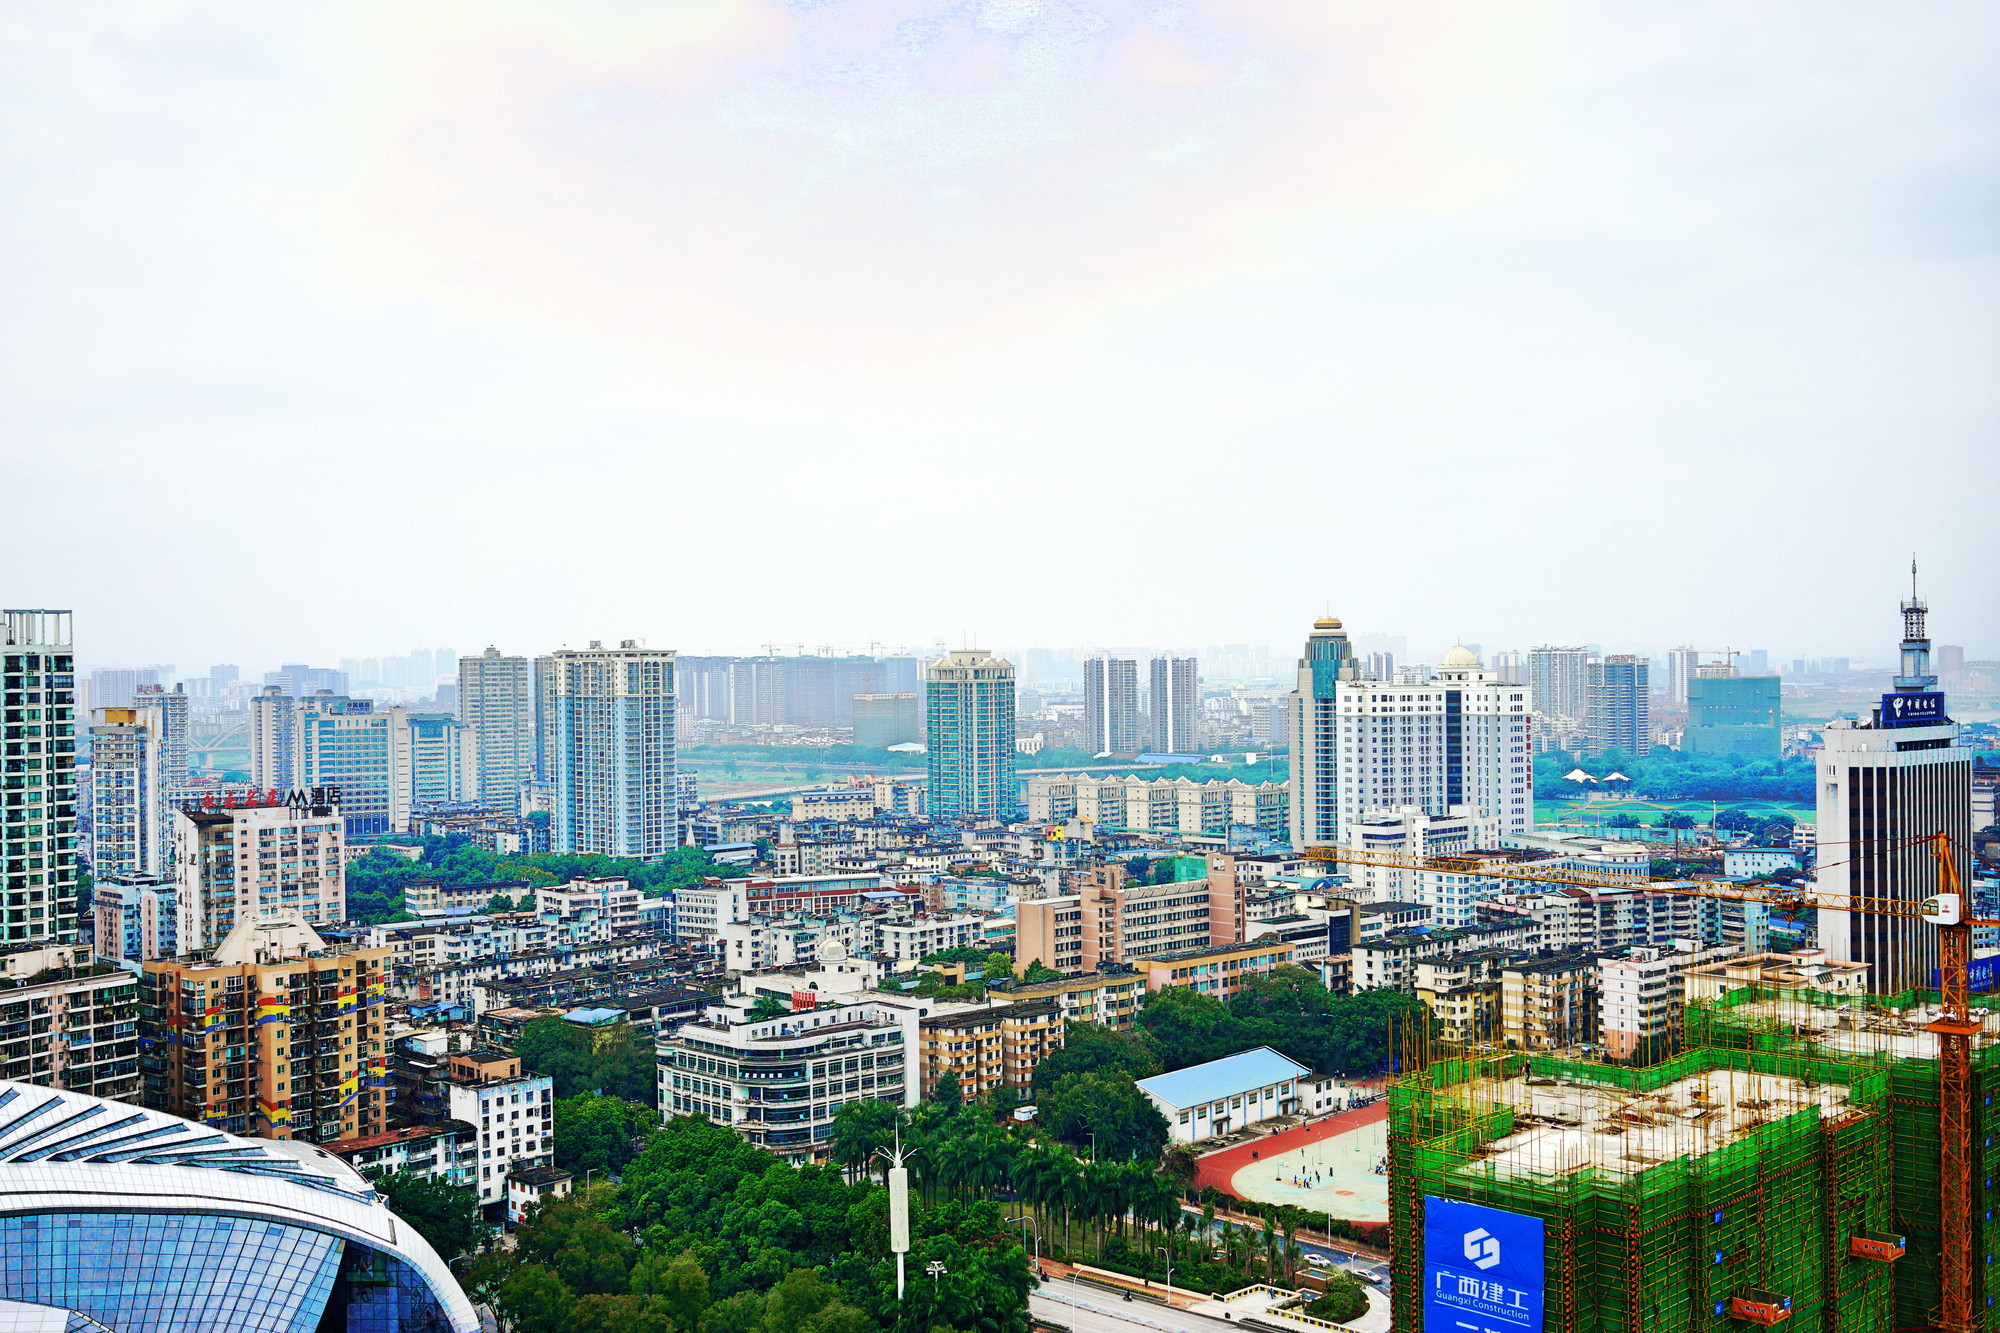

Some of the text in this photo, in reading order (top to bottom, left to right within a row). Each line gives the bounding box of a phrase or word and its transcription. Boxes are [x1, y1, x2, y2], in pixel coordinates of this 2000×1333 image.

[1436, 1270, 1529, 1311] 广西建工
[1436, 1289, 1530, 1321] Guangxi Construction
